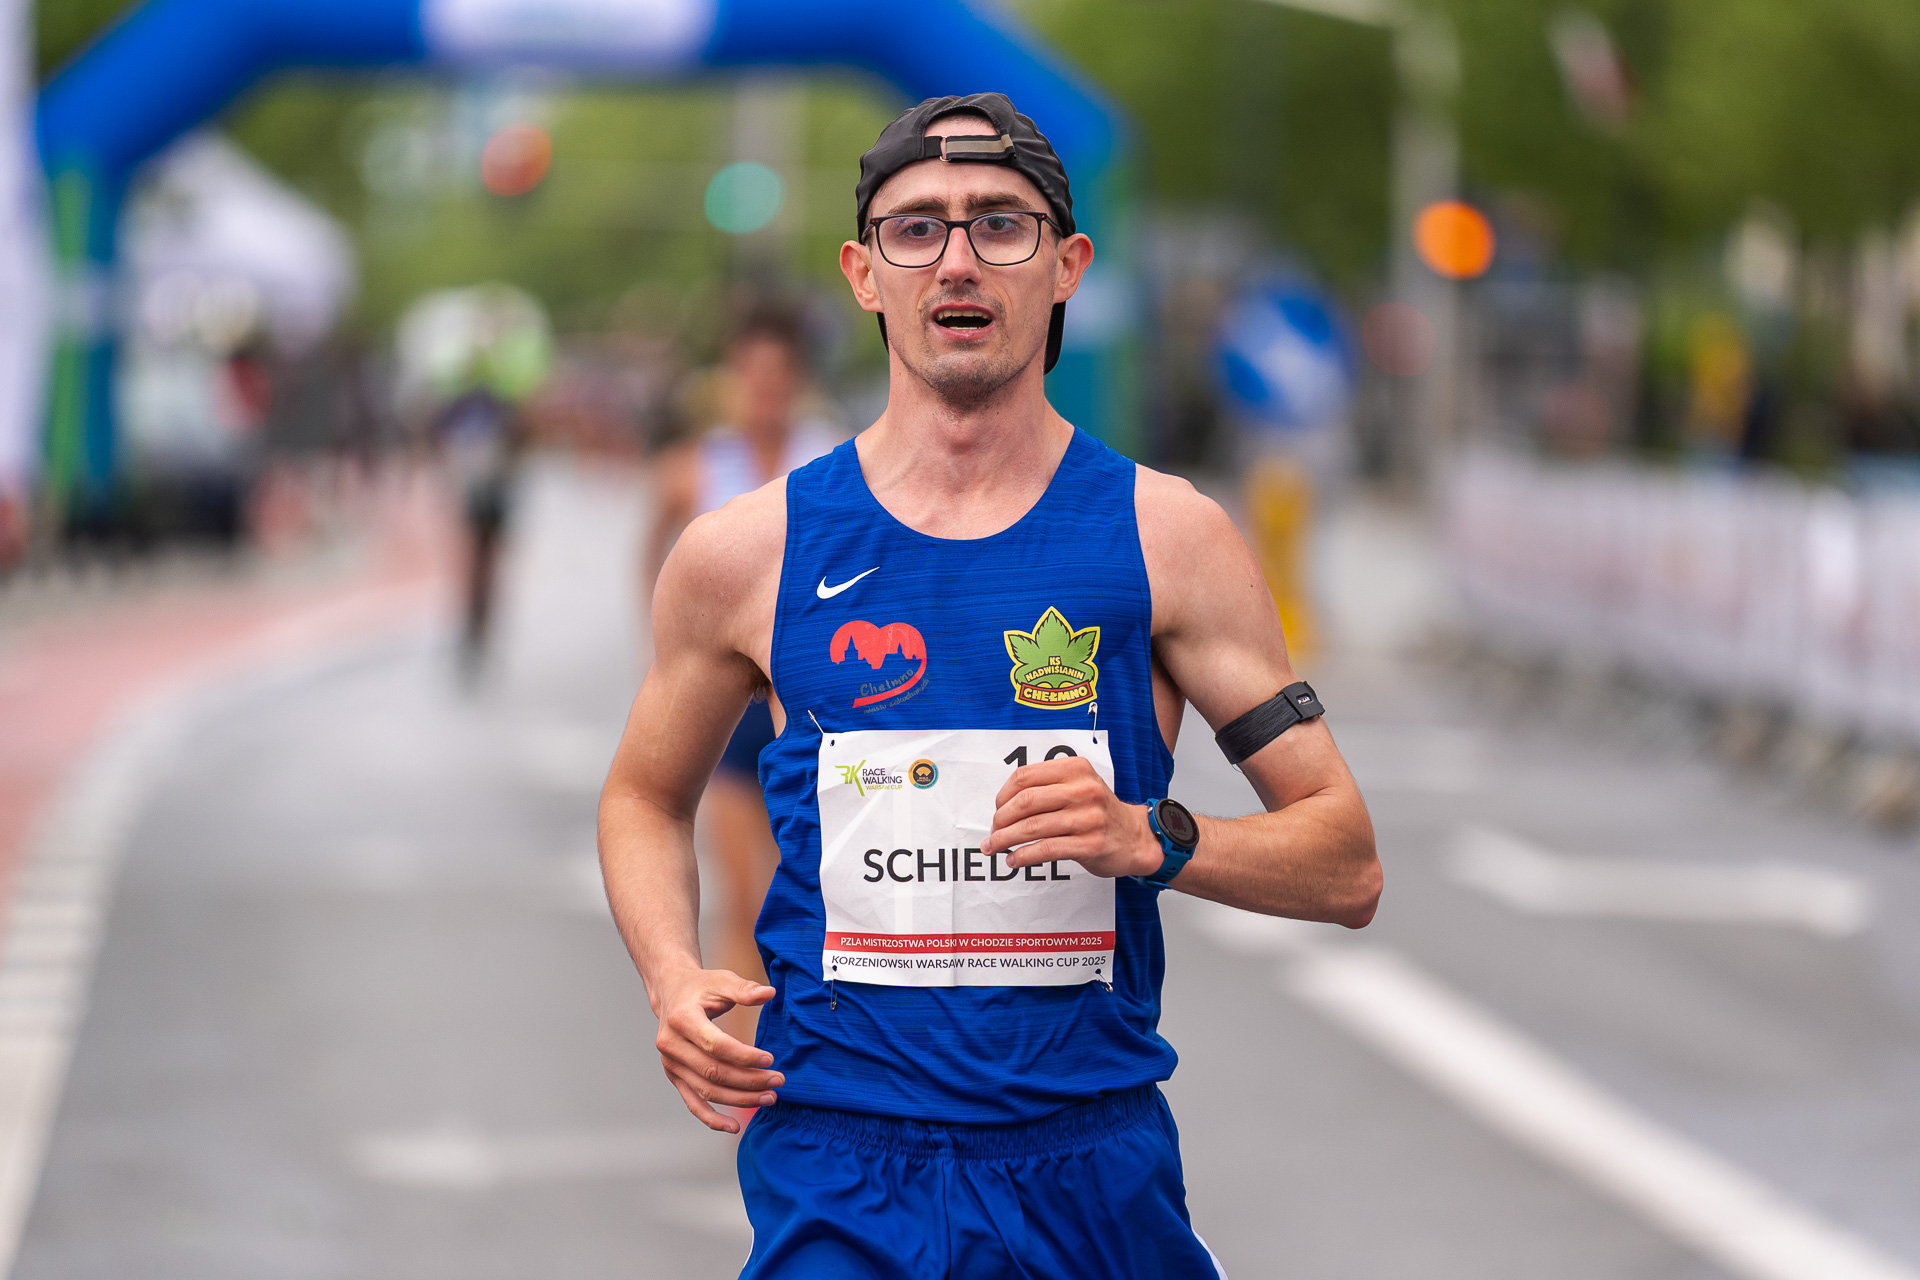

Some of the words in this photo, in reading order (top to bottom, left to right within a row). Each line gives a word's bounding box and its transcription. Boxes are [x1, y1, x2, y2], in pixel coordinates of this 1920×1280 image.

[1049, 656, 1061, 666] KS
[1023, 686, 1088, 702] CHEŁMNO
[862, 768, 886, 776] RACE
[862, 776, 903, 785] WALKING
[863, 848, 1071, 883] SCHIEDEL
[841, 937, 862, 946] PZLA
[863, 938, 925, 948] MISTRZOSTWA
[926, 939, 957, 948] POLSKI
[959, 939, 969, 947] W
[970, 938, 1014, 947] CHODZIE
[1015, 937, 1078, 946] SPORTOWYM
[1080, 937, 1102, 946] 2025
[831, 955, 913, 968] KORZENIOWSKI
[916, 959, 965, 969] WARSAW
[967, 958, 997, 968] RACE
[1000, 958, 1054, 968] WALKING
[1056, 957, 1080, 967] CUP
[1081, 956, 1106, 967] 2025
